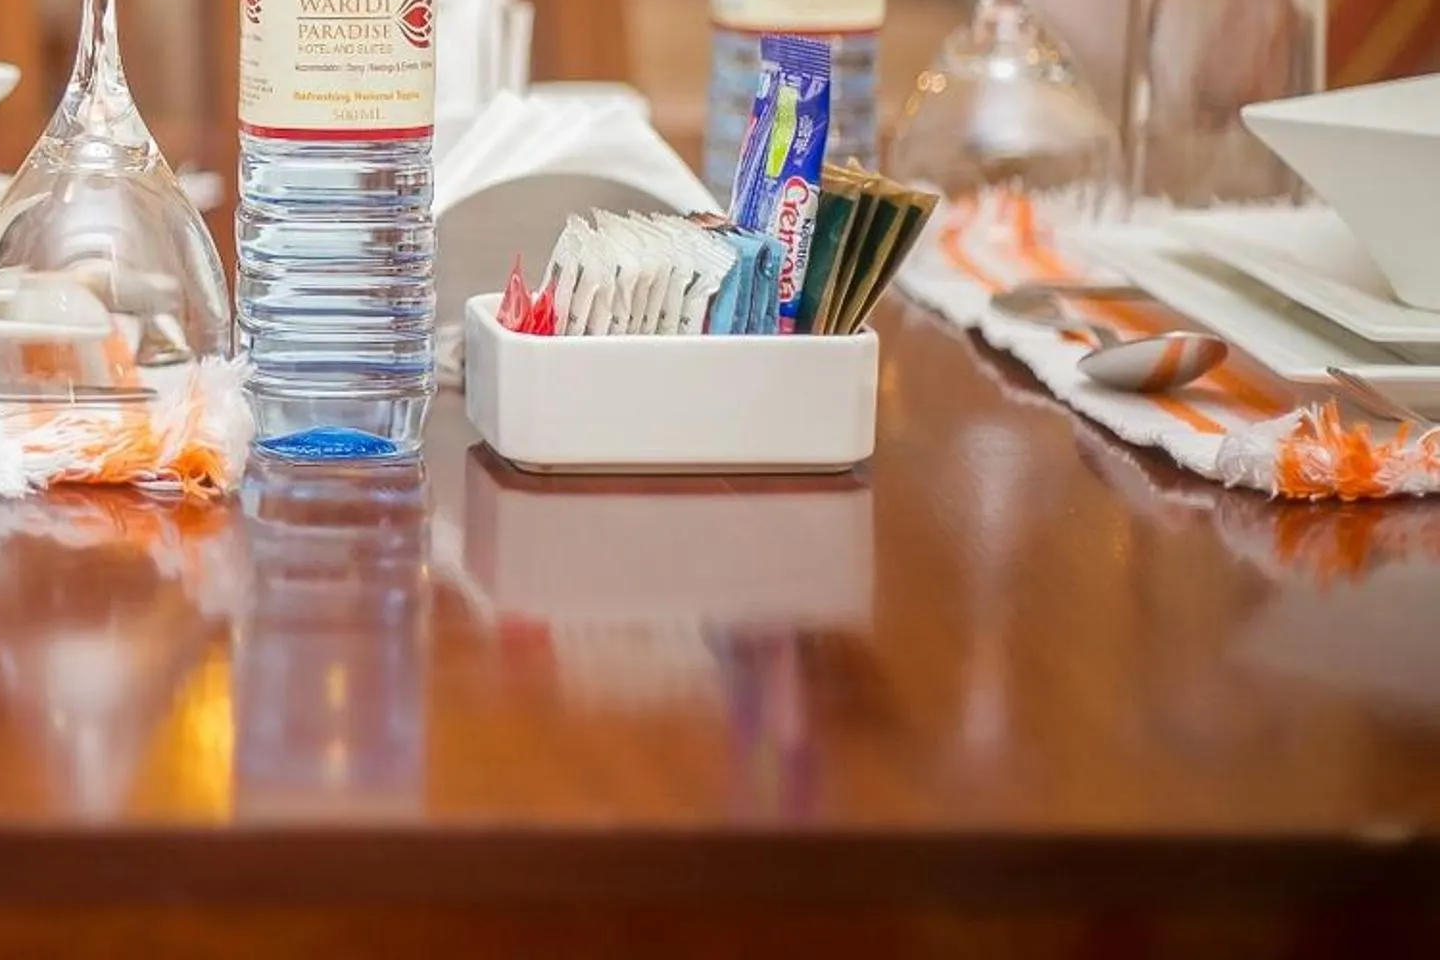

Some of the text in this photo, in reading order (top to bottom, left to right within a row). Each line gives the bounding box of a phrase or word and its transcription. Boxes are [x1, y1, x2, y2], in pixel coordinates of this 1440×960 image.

[298, 23, 392, 39] PARADISE
[298, 42, 331, 54] HOTEL
[334, 42, 355, 54] AND
